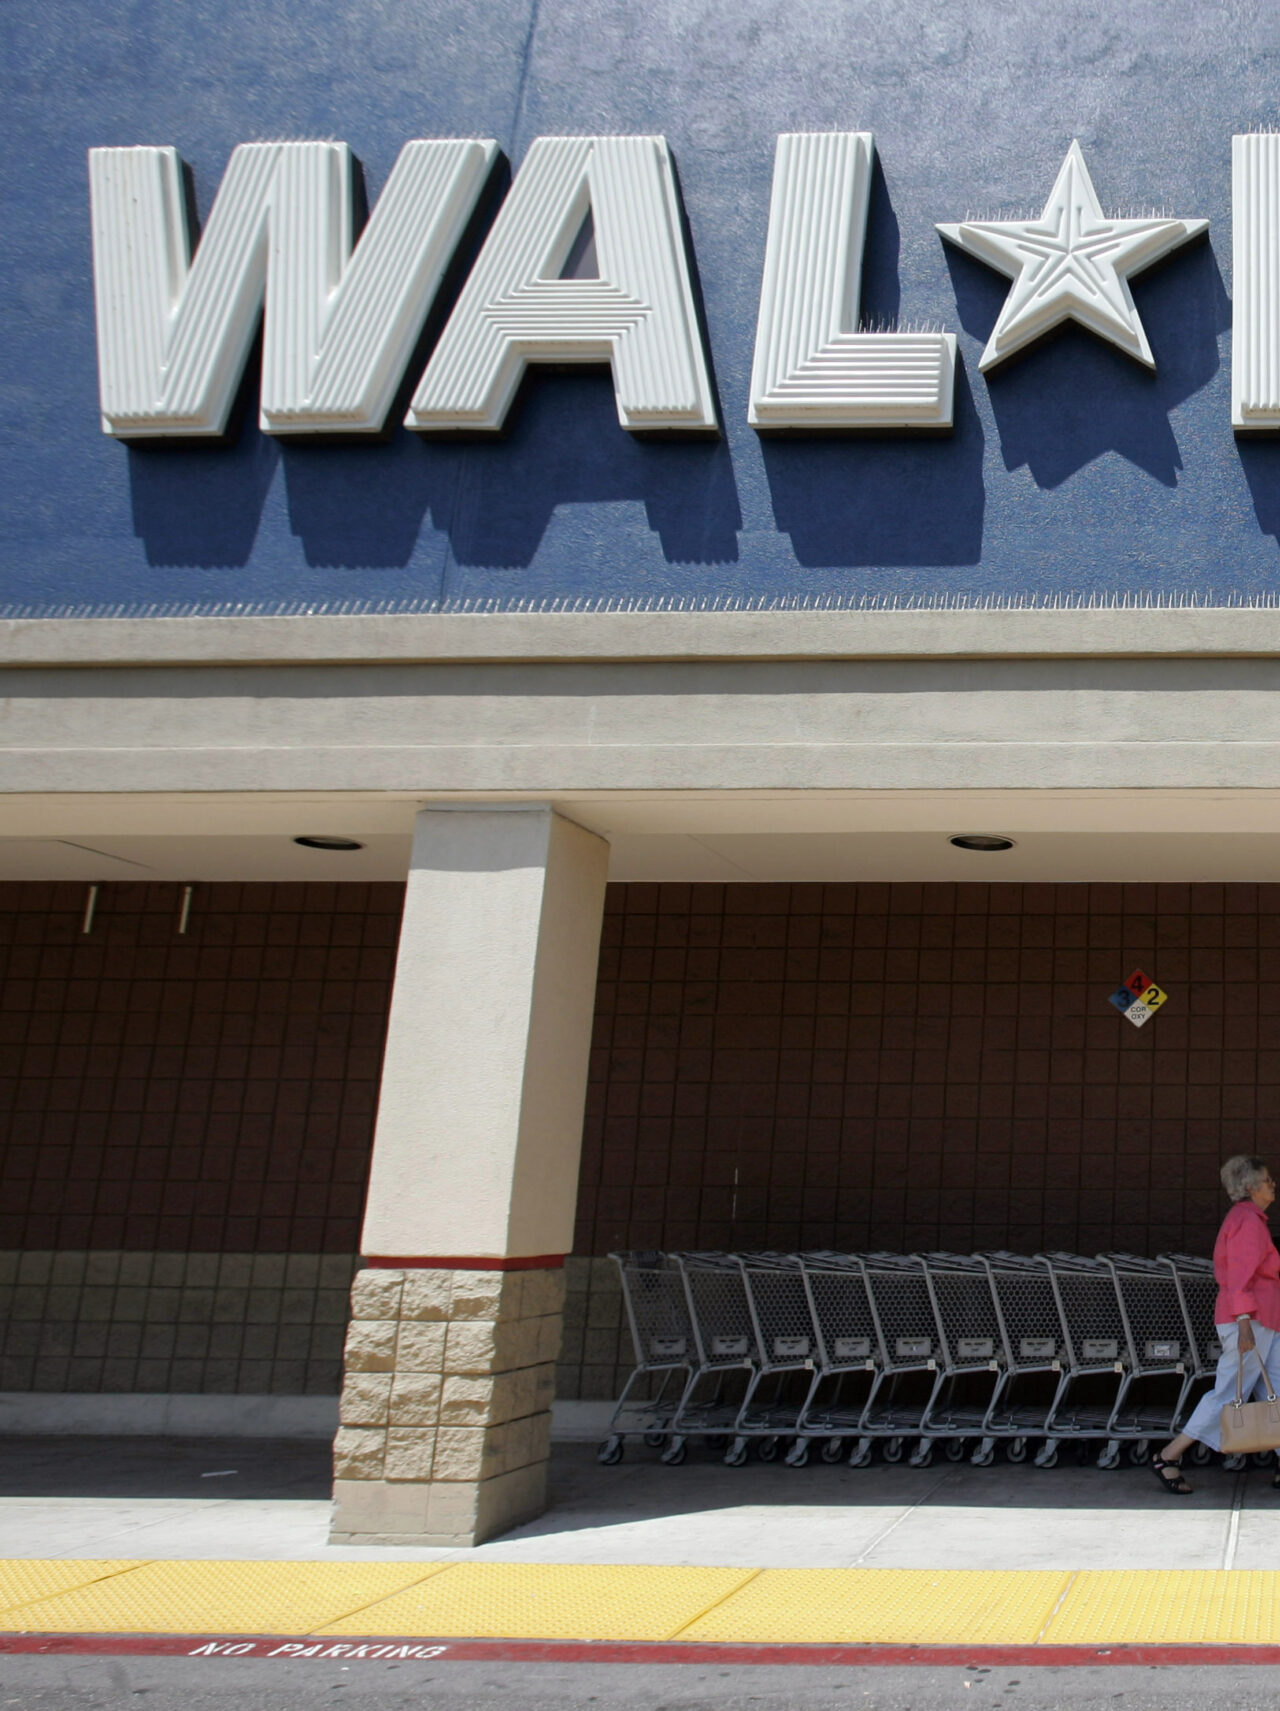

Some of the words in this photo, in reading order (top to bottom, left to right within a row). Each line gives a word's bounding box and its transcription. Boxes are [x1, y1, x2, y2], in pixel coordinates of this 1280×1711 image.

[1131, 975, 1144, 992] 4
[1118, 990, 1130, 1007] 3
[1147, 988, 1159, 1005] 2
[188, 1642, 257, 1656] NO
[266, 1643, 448, 1659] PARKING
